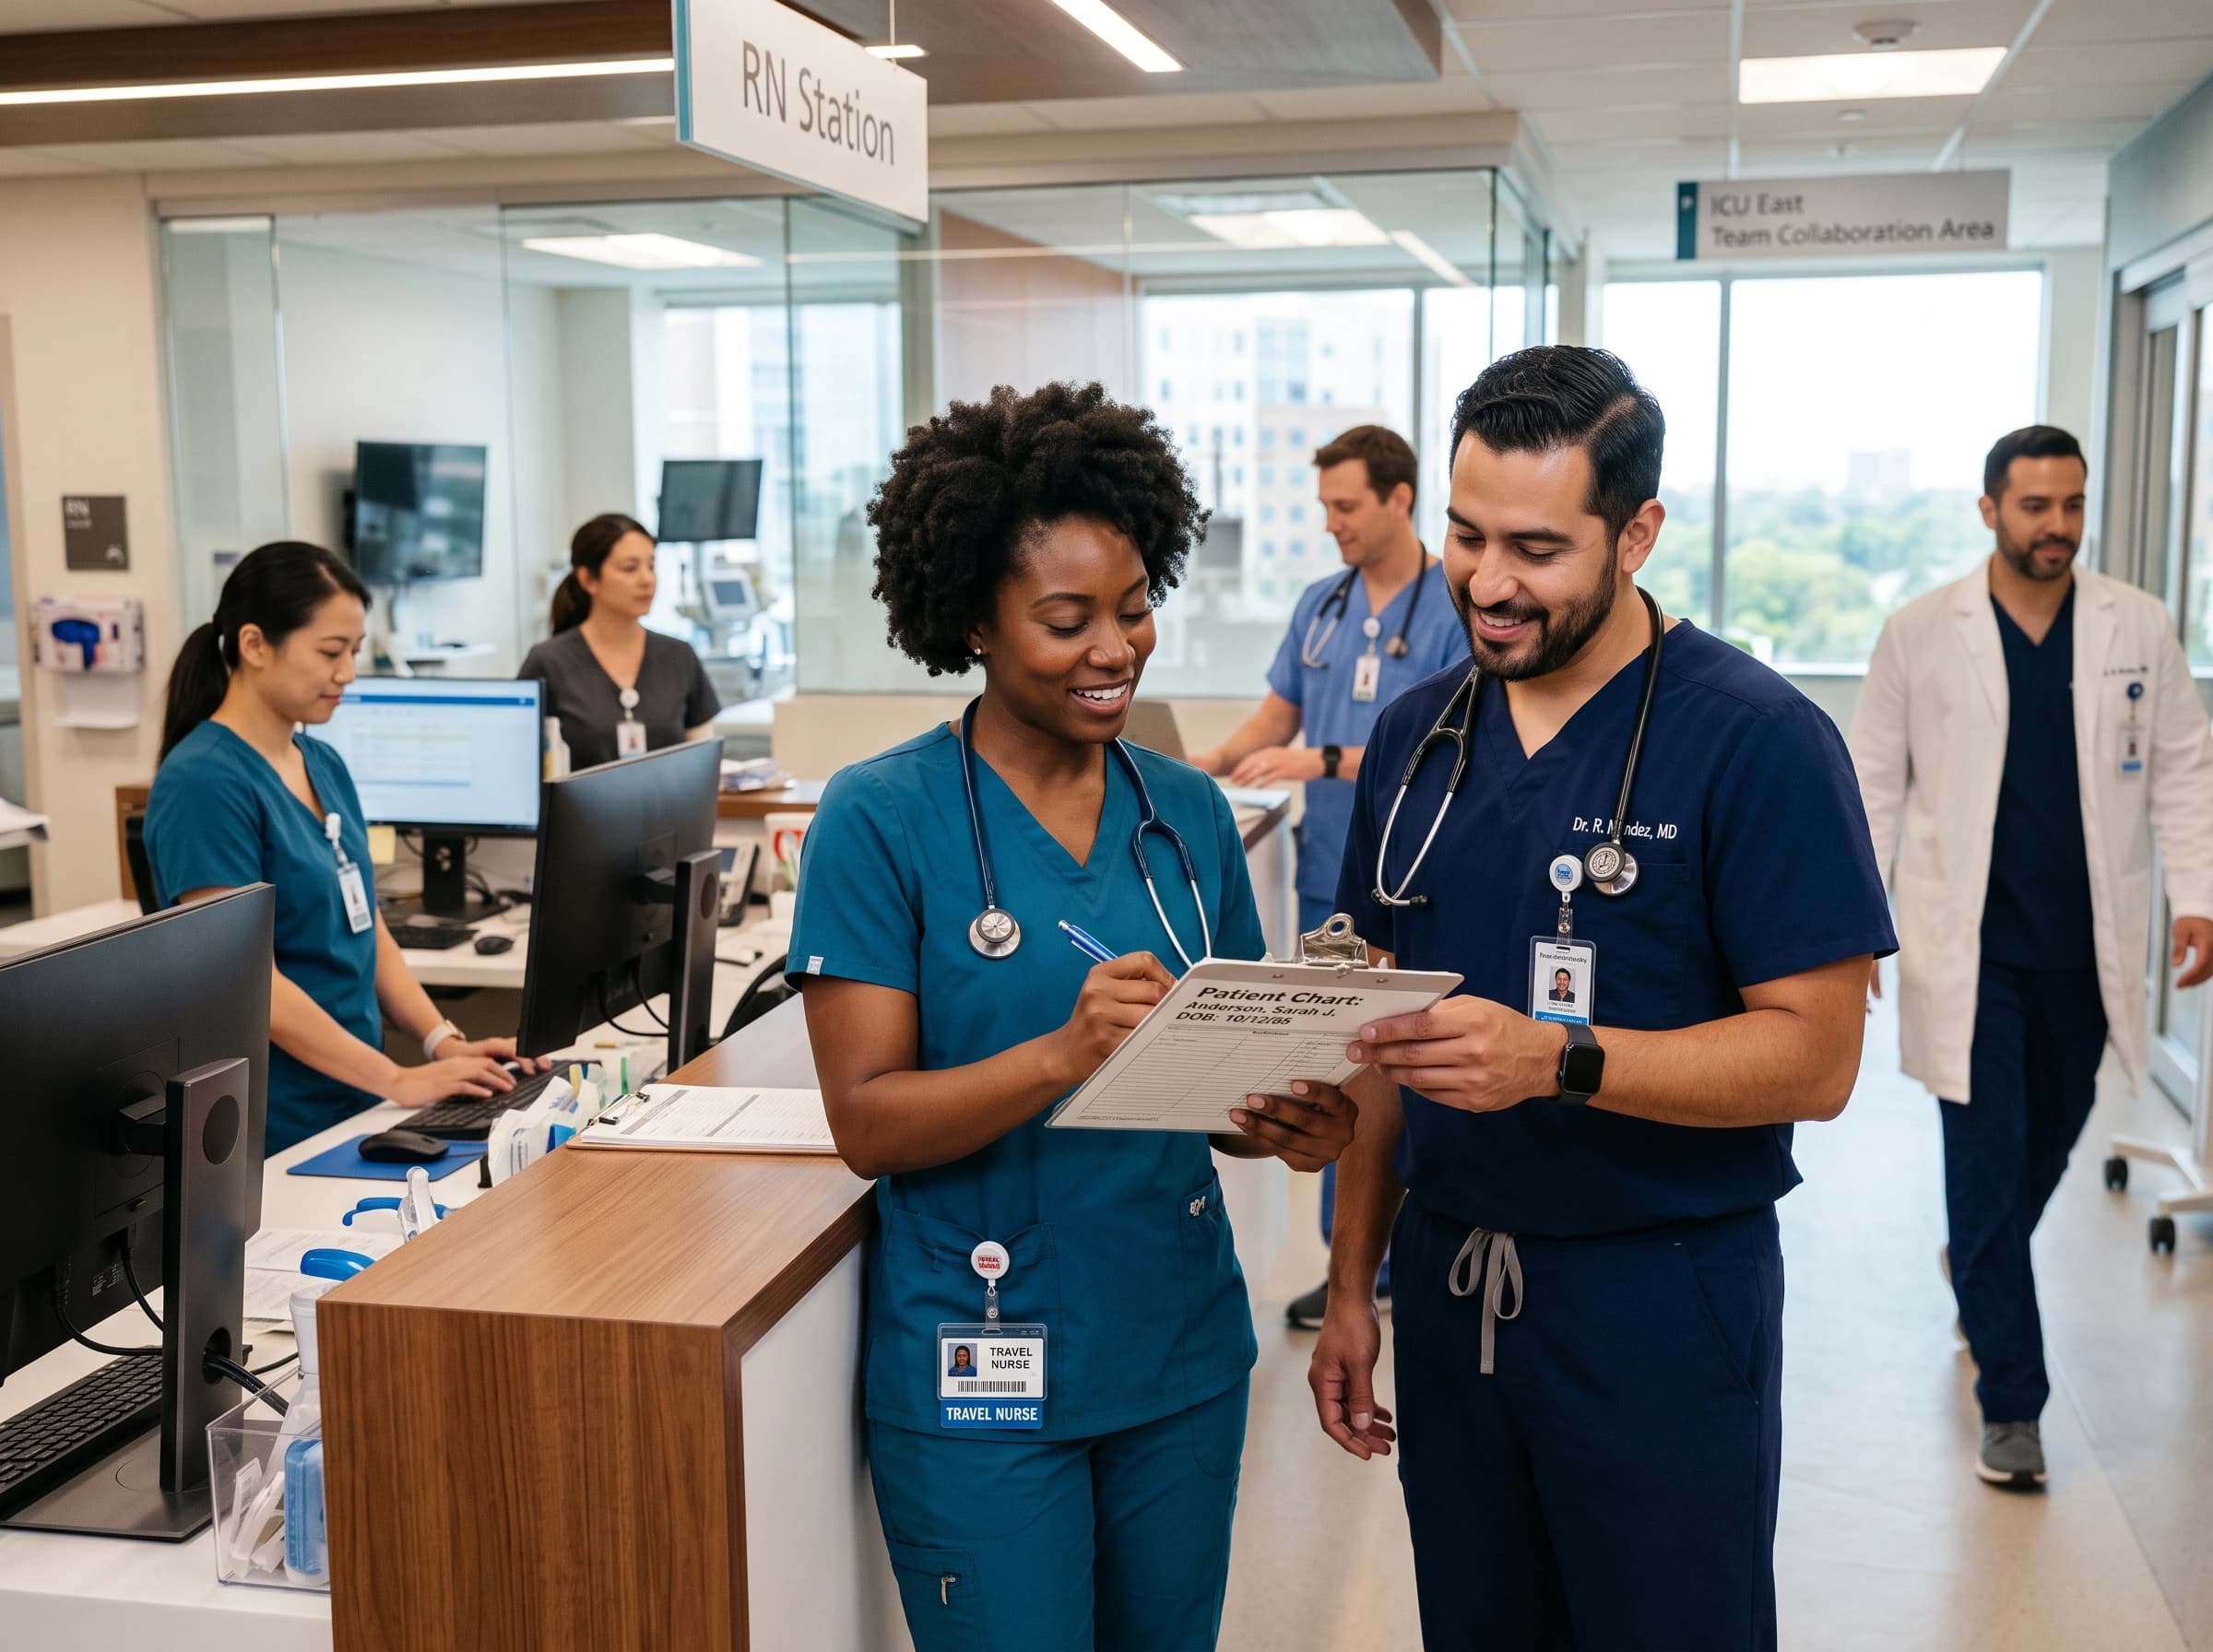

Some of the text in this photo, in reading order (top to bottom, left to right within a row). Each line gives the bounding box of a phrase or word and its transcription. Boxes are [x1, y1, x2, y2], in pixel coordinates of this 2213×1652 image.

[742, 39, 894, 167] RN Station
[1710, 193, 1805, 218] ICU East
[1712, 217, 1996, 248] Team Collaboration Area
[1572, 817, 1678, 840] Dr. R. Mndez, MD
[1197, 986, 1365, 1006] Patient Chart:
[1175, 1011, 1220, 1022] DOB:
[1272, 1006, 1320, 1016] Sarah
[1321, 1009, 1336, 1017] J.
[989, 1347, 1033, 1357] TRAVEL
[991, 1360, 1031, 1370] NURSE
[946, 1407, 1038, 1421] TRAVEL NURSE
